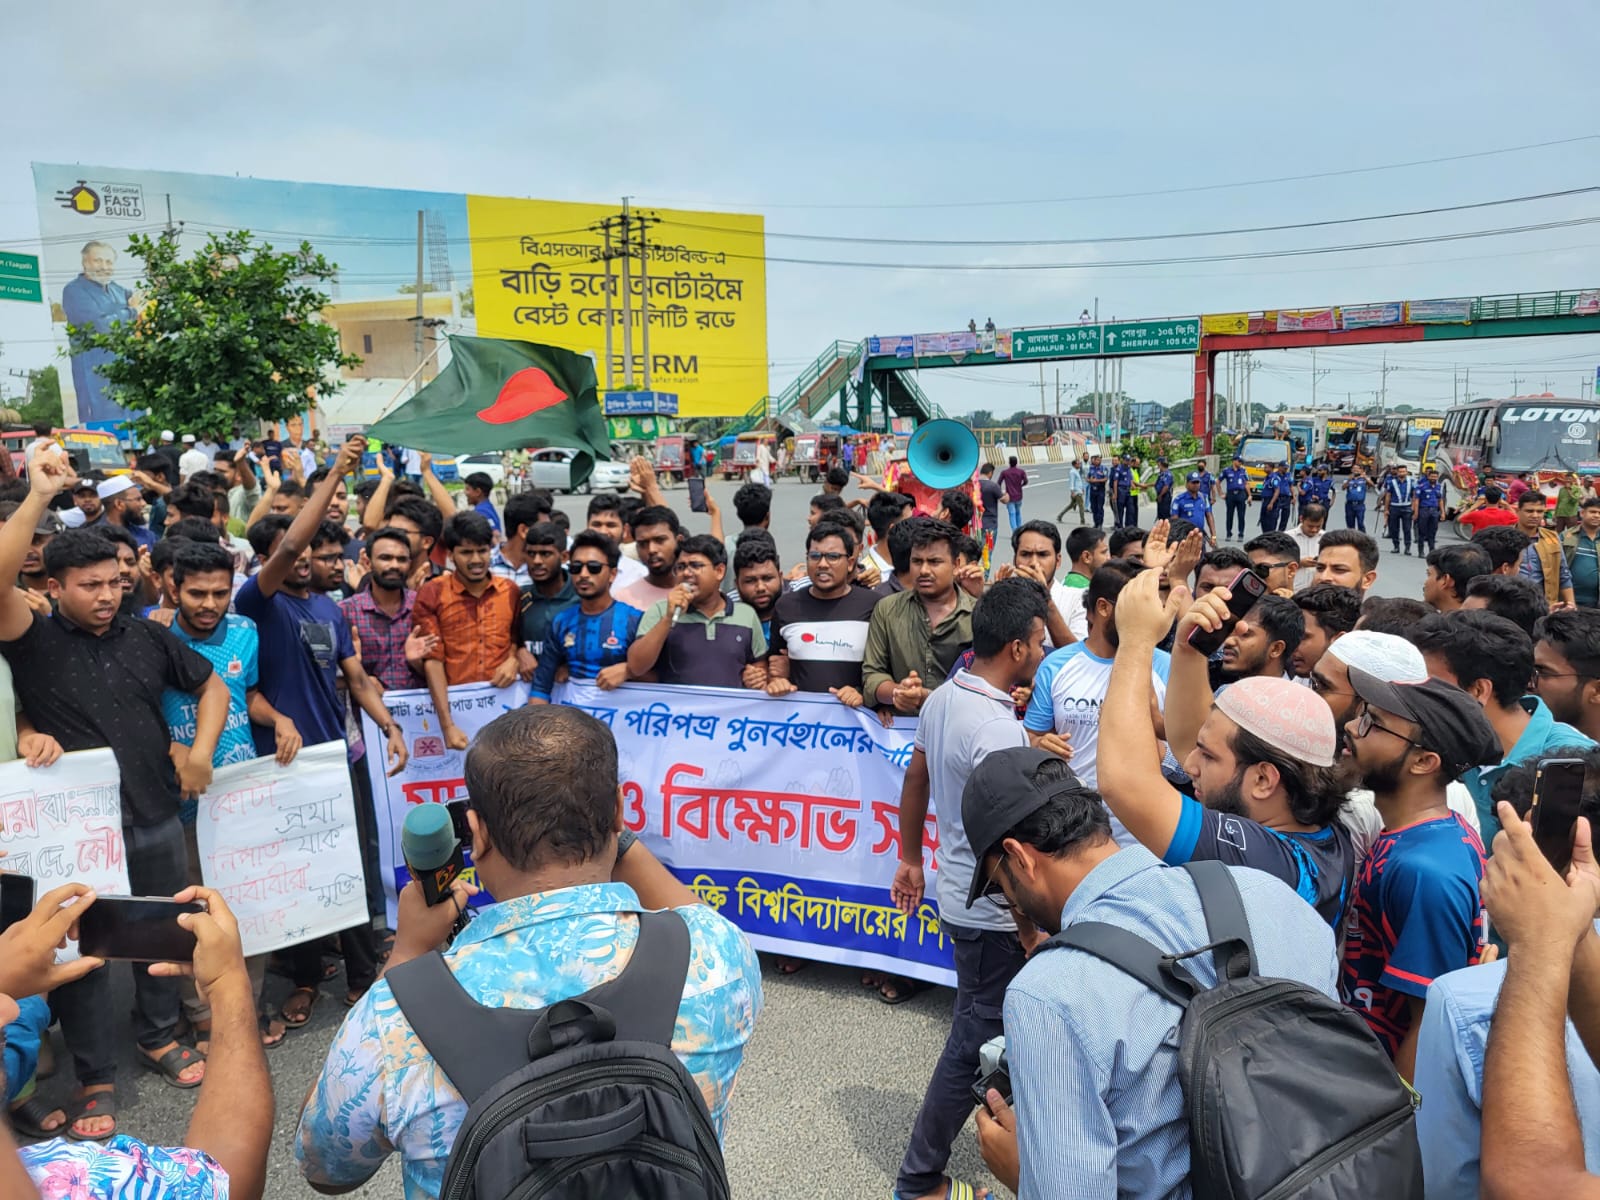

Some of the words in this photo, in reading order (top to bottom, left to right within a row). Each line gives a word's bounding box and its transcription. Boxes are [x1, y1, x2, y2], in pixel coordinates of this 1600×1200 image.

[104, 195, 139, 207] FAST
[105, 207, 142, 217] BUILD
[499, 262, 561, 299] বাড়ি
[513, 303, 569, 326] বেস্ট
[695, 310, 736, 330] রডে
[1026, 343, 1065, 354] JAMALPUR
[1120, 338, 1159, 348] SHERPUR
[625, 702, 720, 740] পরিপত্র
[727, 712, 875, 753] পুনর্বহালের
[660, 763, 862, 850] বিক্ষোভ
[735, 876, 910, 942] বিশ্ববিদ্যালয়ের
